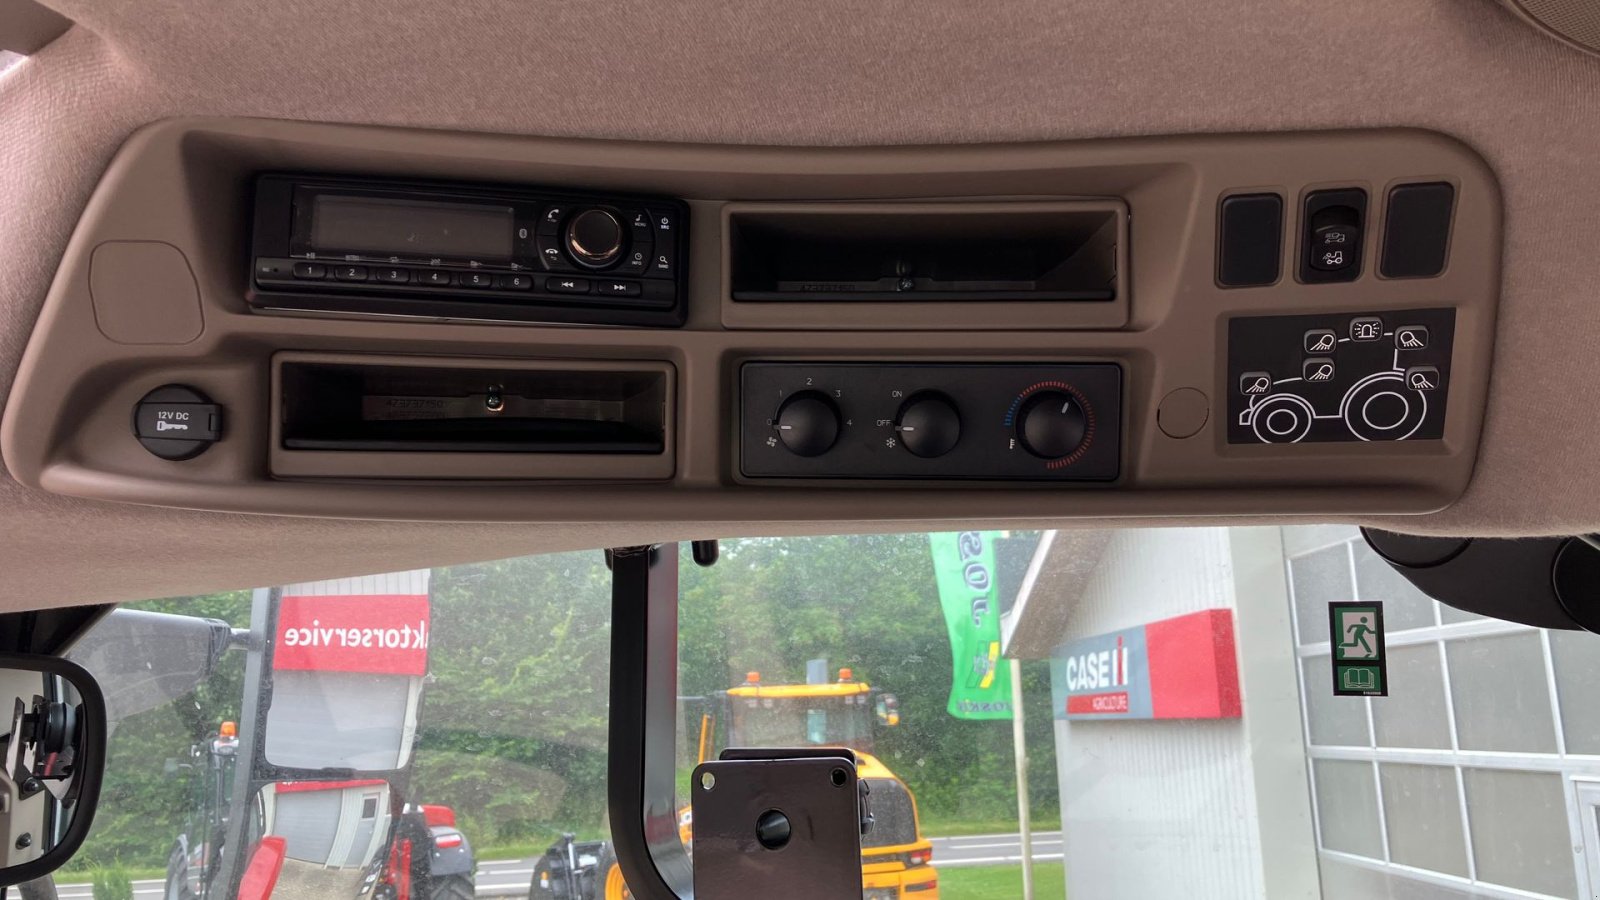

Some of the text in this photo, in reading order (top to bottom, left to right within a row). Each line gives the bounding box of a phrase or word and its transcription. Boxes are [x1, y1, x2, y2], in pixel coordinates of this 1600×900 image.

[308, 266, 312, 274] 1
[349, 268, 355, 276] 2
[391, 271, 397, 279] 3
[431, 273, 438, 281] 4
[473, 275, 479, 283] 5
[806, 378, 813, 386] 2
[835, 389, 841, 398] 3
[892, 390, 902, 398] ON
[158, 411, 189, 420] 12V DC
[876, 419, 891, 427] OFF
[1066, 650, 1110, 691] CASE
